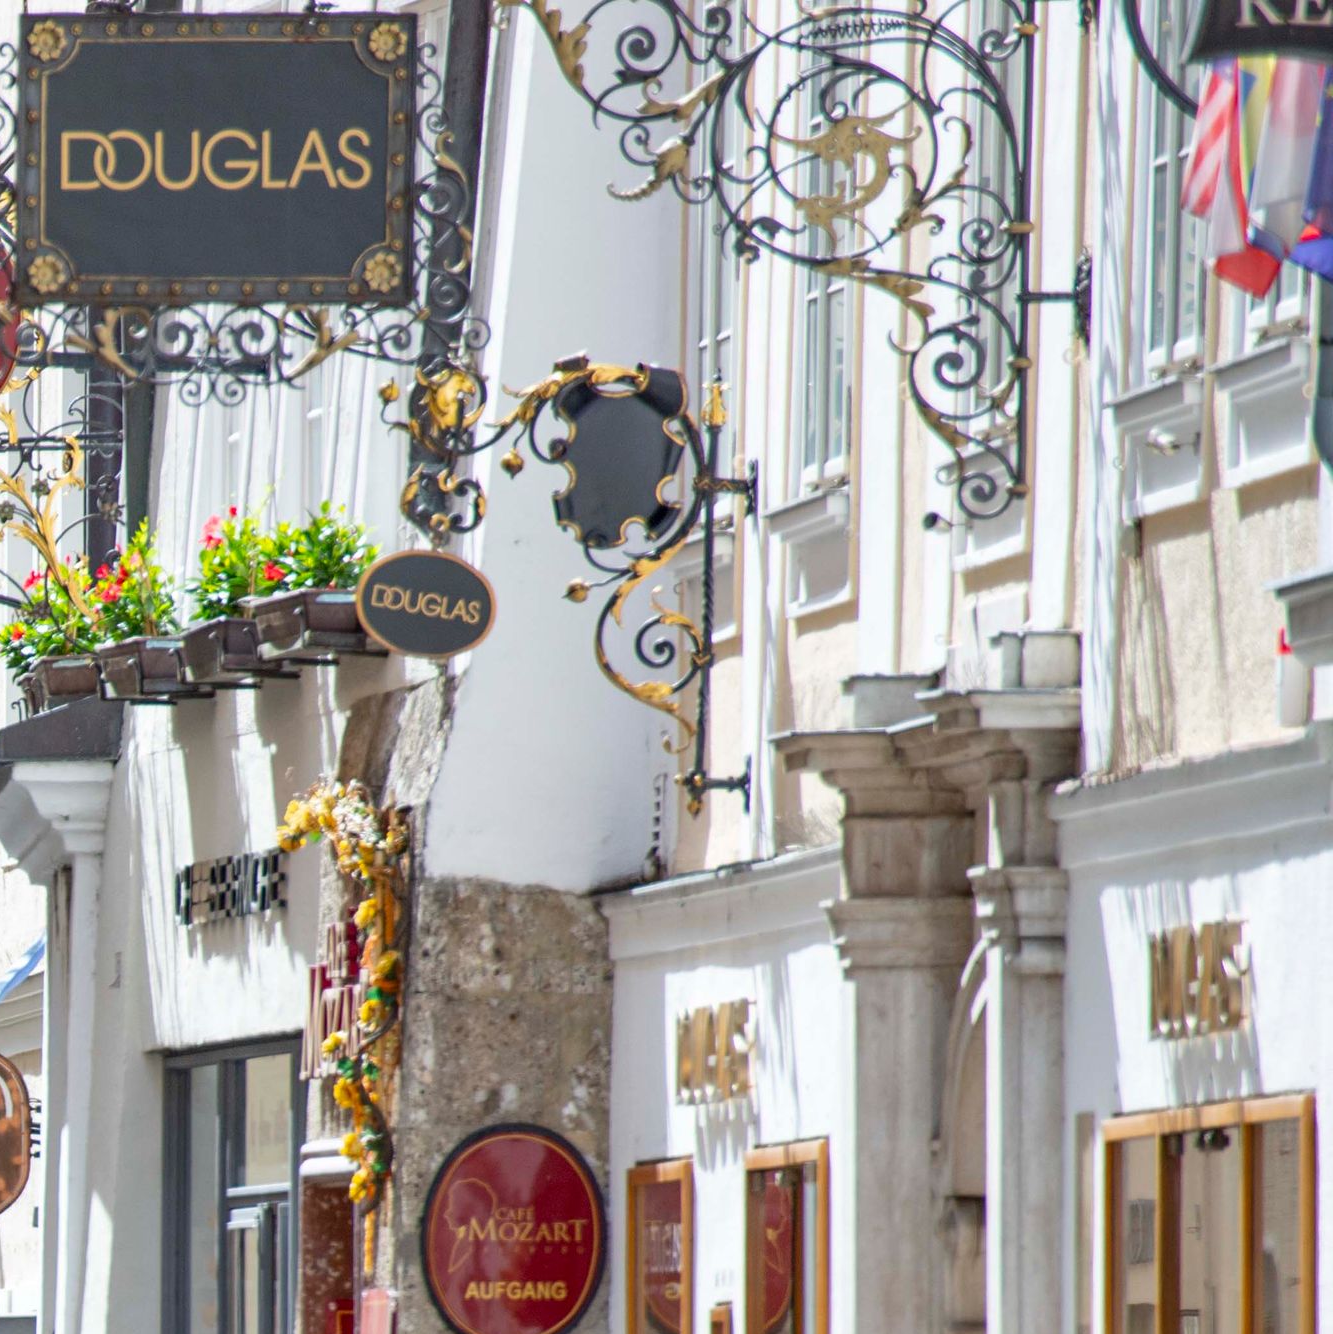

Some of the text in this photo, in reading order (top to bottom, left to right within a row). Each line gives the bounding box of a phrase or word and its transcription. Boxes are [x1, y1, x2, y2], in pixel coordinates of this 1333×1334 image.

[61, 128, 374, 190] DOUGLAS
[370, 583, 482, 625] DOUGLAS
[468, 1217, 588, 1241] MOZART
[465, 1280, 568, 1300] AUFGANG
